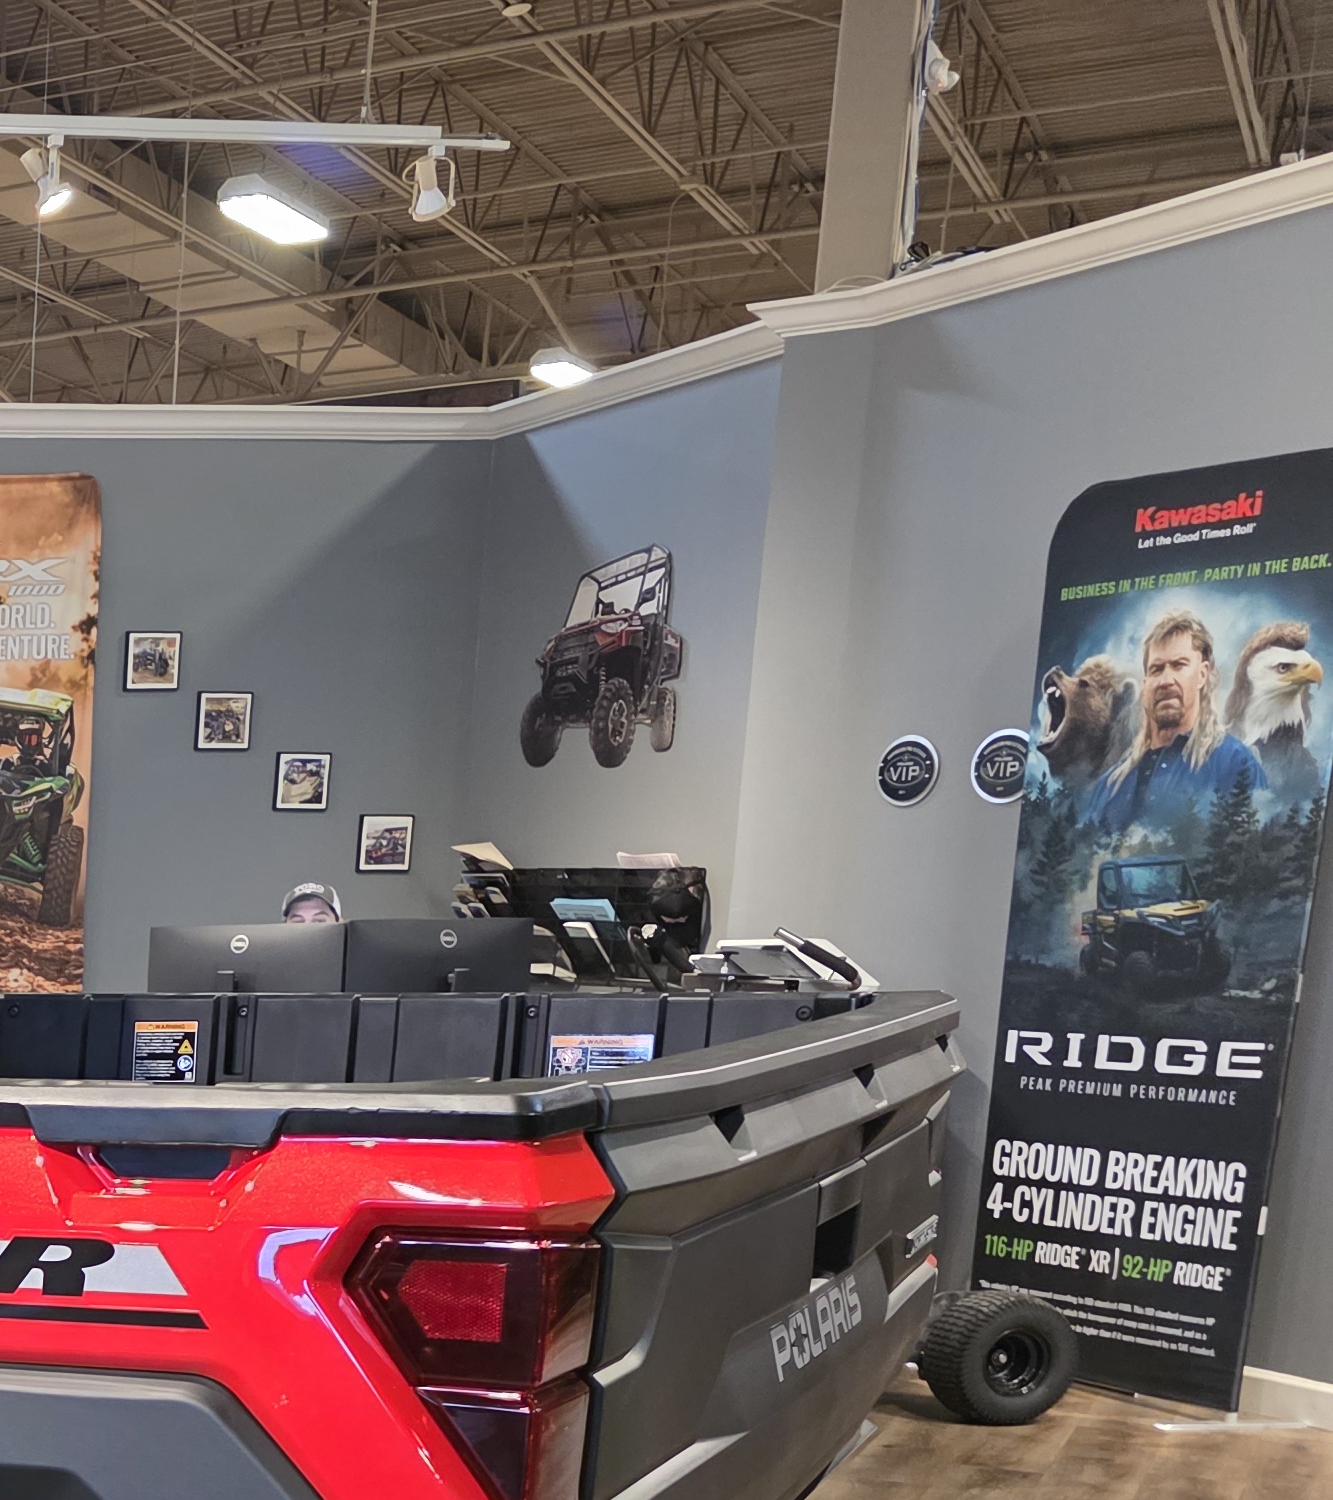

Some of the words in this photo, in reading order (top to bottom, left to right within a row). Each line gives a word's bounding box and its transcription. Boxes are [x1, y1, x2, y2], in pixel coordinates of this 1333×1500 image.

[1135, 490, 1263, 532] Kawasaki
[1138, 537, 1153, 549] Let
[1156, 535, 1172, 546] the
[1173, 530, 1200, 543] Good
[1201, 527, 1231, 540] Times
[1233, 524, 1254, 535] Roll
[8, 584, 66, 596] 1000
[1061, 581, 1116, 601] BUSINESS
[1118, 579, 1131, 593] IN
[1134, 575, 1156, 591] THE
[1159, 570, 1199, 588] FRONT,
[1203, 564, 1244, 582] PARTY
[1247, 562, 1261, 577] IN
[1264, 559, 1289, 575] THE
[1292, 553, 1332, 571] BACK.
[889, 766, 920, 781] VIP
[986, 761, 1019, 777] VIP
[1005, 1029, 1265, 1079] RIDGE
[1020, 1076, 1052, 1091] PEAK
[1059, 1078, 1122, 1097] PREMIUM
[1129, 1084, 1237, 1106] PERFORMANCE
[992, 1139, 1099, 1187] GROUND
[1105, 1150, 1247, 1203] BREAKING
[986, 1182, 1134, 1237] 4-CYLINDER
[1140, 1201, 1243, 1251] ENGINE
[985, 1234, 1034, 1261] 116-HP
[1035, 1241, 1080, 1269] RIDGE
[1088, 1249, 1111, 1274] XR
[1121, 1254, 1173, 1282] 92-HP
[1173, 1261, 1224, 1291] RIDGE
[770, 1273, 862, 1382] POLARIS
